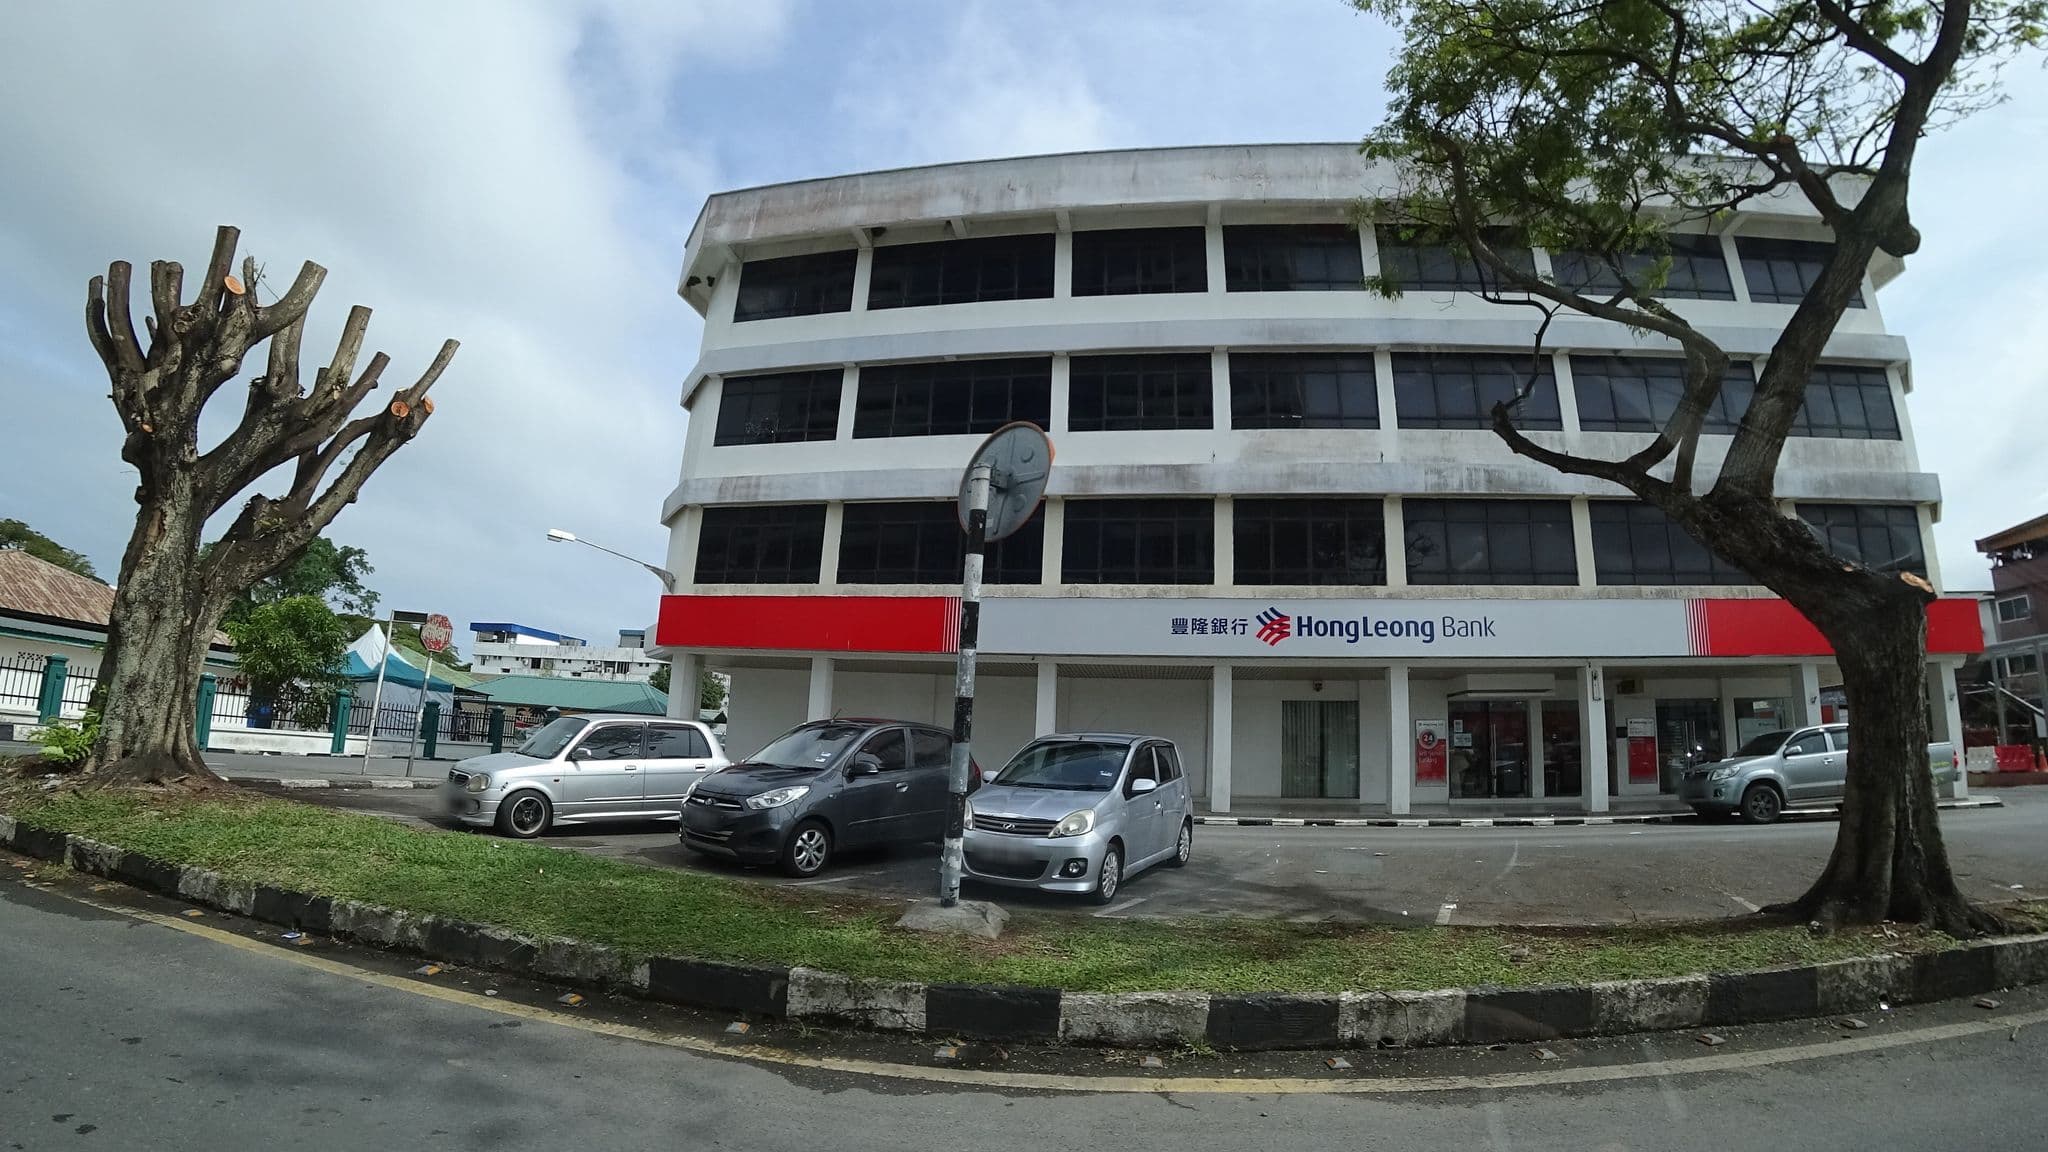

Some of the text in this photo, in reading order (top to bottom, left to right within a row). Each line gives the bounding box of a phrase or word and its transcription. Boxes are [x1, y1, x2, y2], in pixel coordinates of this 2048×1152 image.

[1171, 617, 1248, 635] 豐隆銀行
[1297, 615, 1496, 644] HongLeong Bank
